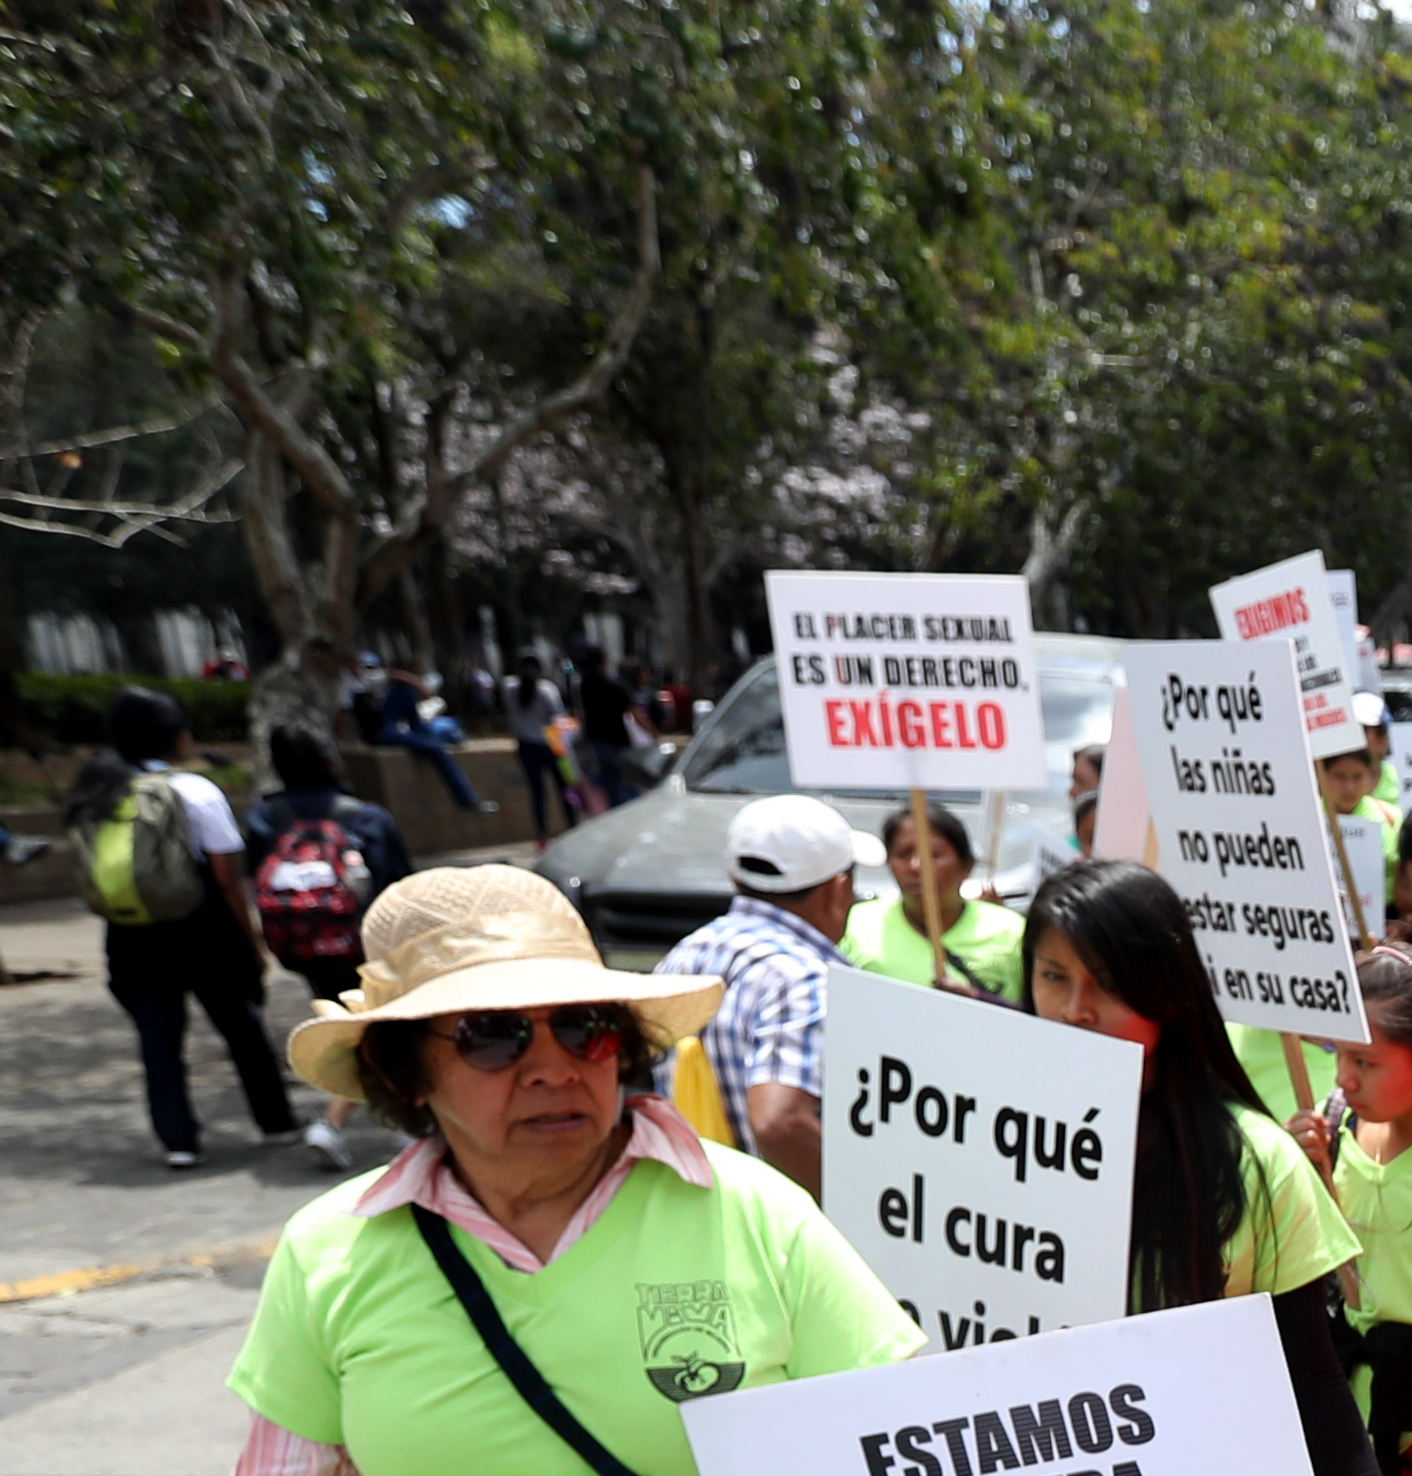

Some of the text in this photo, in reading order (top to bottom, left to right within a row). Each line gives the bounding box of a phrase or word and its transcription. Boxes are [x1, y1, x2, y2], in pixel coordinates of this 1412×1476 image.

[795, 613, 1013, 642] EL PLACER SEXUAL
[793, 655, 825, 684] ES
[835, 655, 873, 685] UN
[825, 687, 1006, 750] EXÍGELO
[1160, 670, 1263, 733] ¿Por qué
[1170, 746, 1276, 796] las niñas
[1177, 821, 1305, 877] no pueden
[1242, 901, 1334, 951] seguras
[1224, 967, 1253, 1002] en
[1257, 971, 1286, 1006] su
[1288, 968, 1352, 1015] casa?
[848, 1054, 1103, 1183] ¿Por qué
[879, 1173, 1066, 1284] el cura
